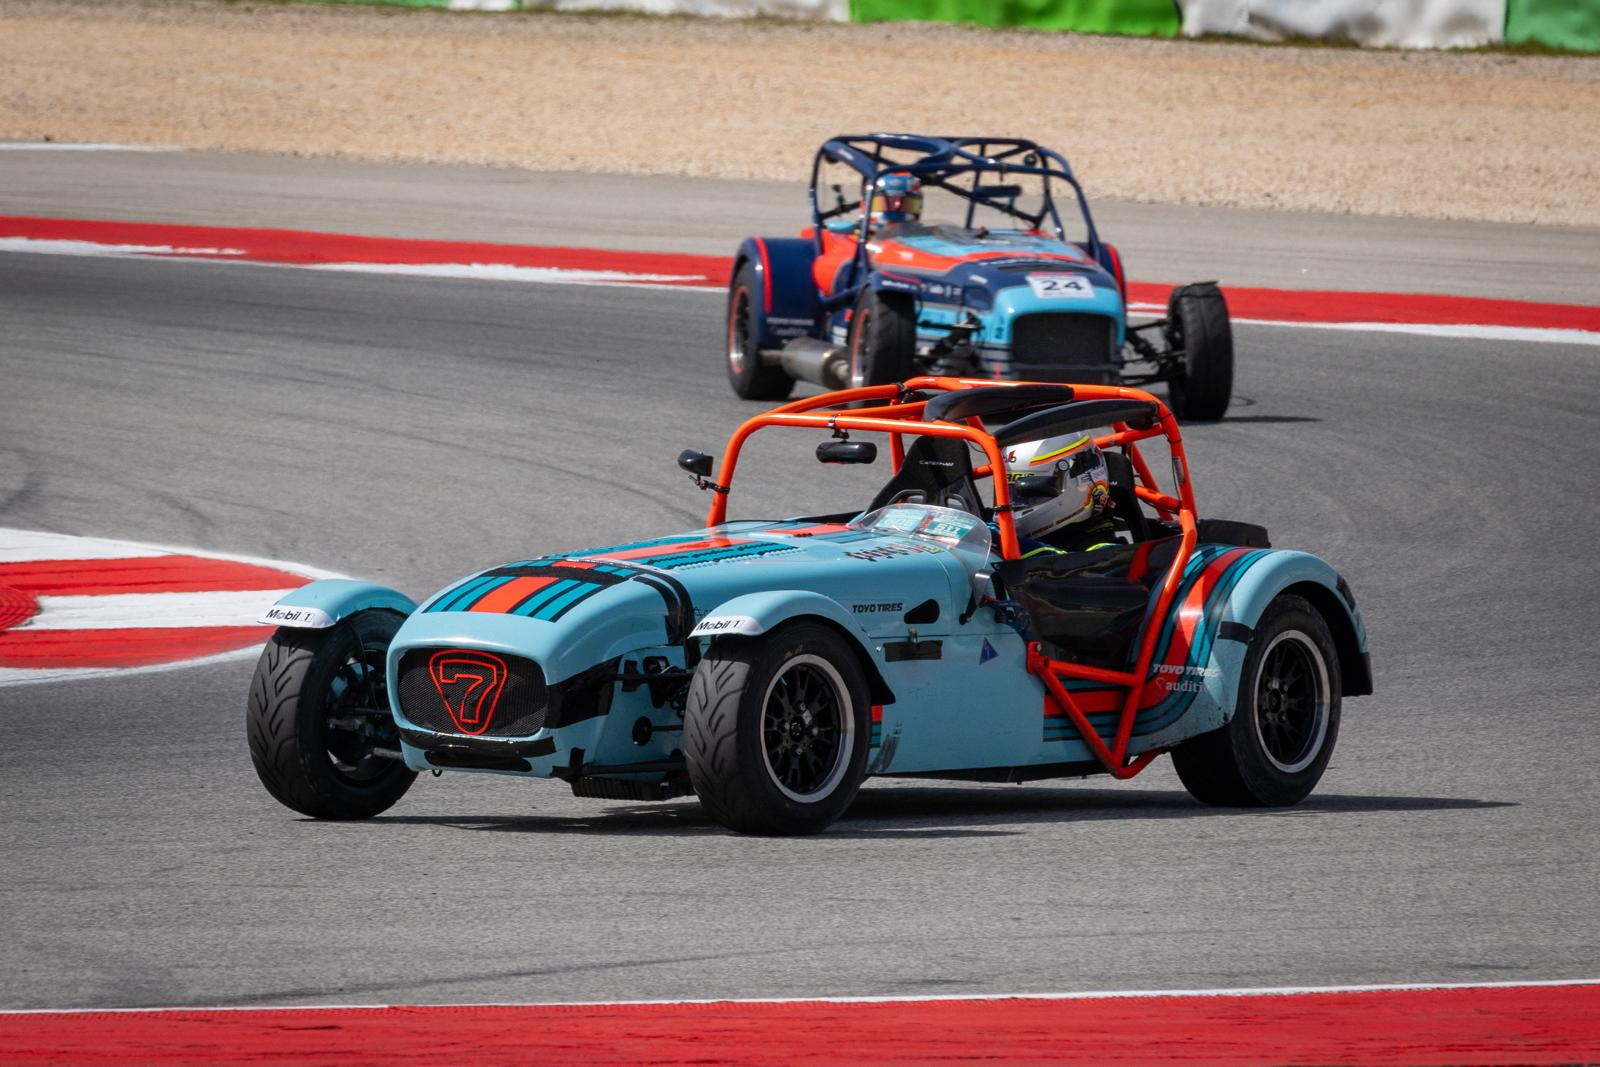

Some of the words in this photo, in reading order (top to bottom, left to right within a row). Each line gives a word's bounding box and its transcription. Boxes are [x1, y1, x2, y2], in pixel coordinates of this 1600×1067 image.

[1040, 279, 1084, 291] 24
[853, 603, 876, 613] TOYO
[877, 602, 903, 612] TIRES
[265, 608, 302, 621] Mobil
[696, 620, 730, 631] Mobil
[1153, 663, 1185, 675] TOYO
[440, 658, 497, 723] 7
